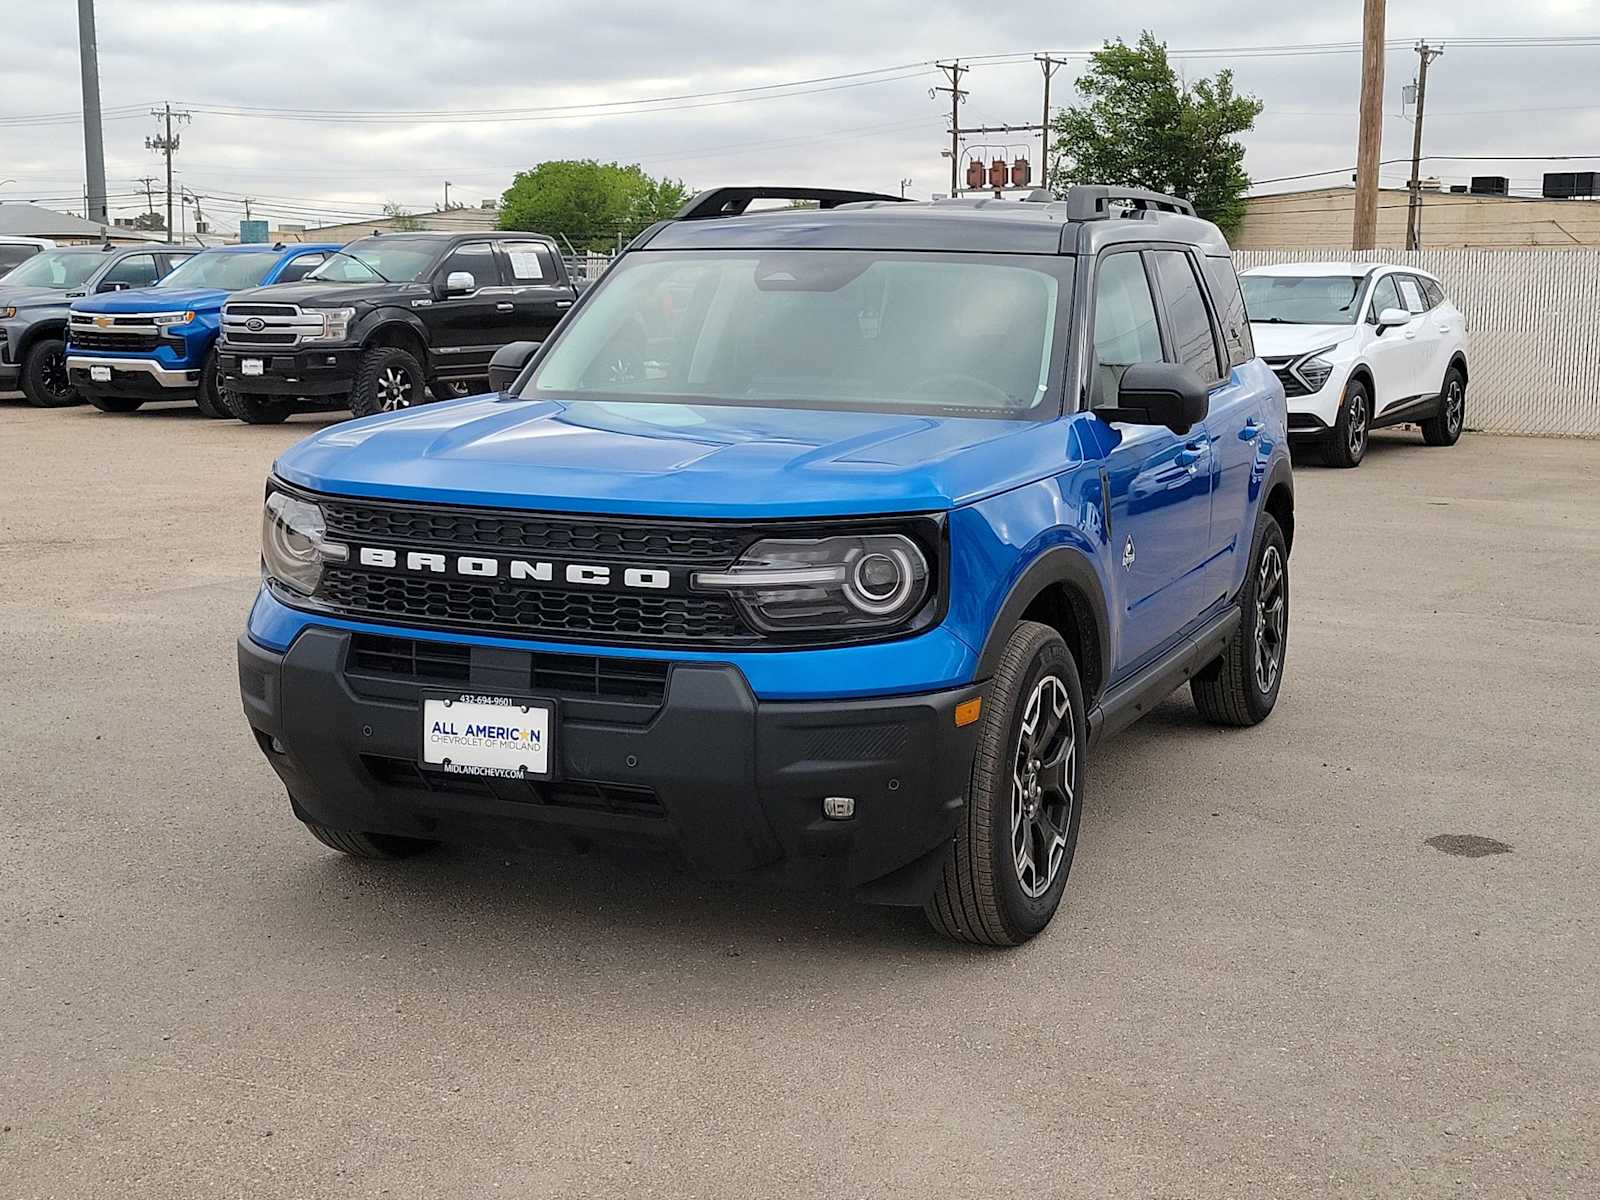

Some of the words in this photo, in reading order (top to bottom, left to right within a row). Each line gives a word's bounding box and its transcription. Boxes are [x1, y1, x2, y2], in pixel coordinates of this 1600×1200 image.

[360, 547, 670, 589] BRONCO
[460, 694, 513, 706] 432-694-9601
[432, 721, 458, 735] ALL
[431, 734, 483, 747] CHEVROLET
[485, 739, 497, 748] OF
[499, 740, 541, 752] MIDLAND
[444, 762, 524, 779] MIDLANDCHEVY.COM
